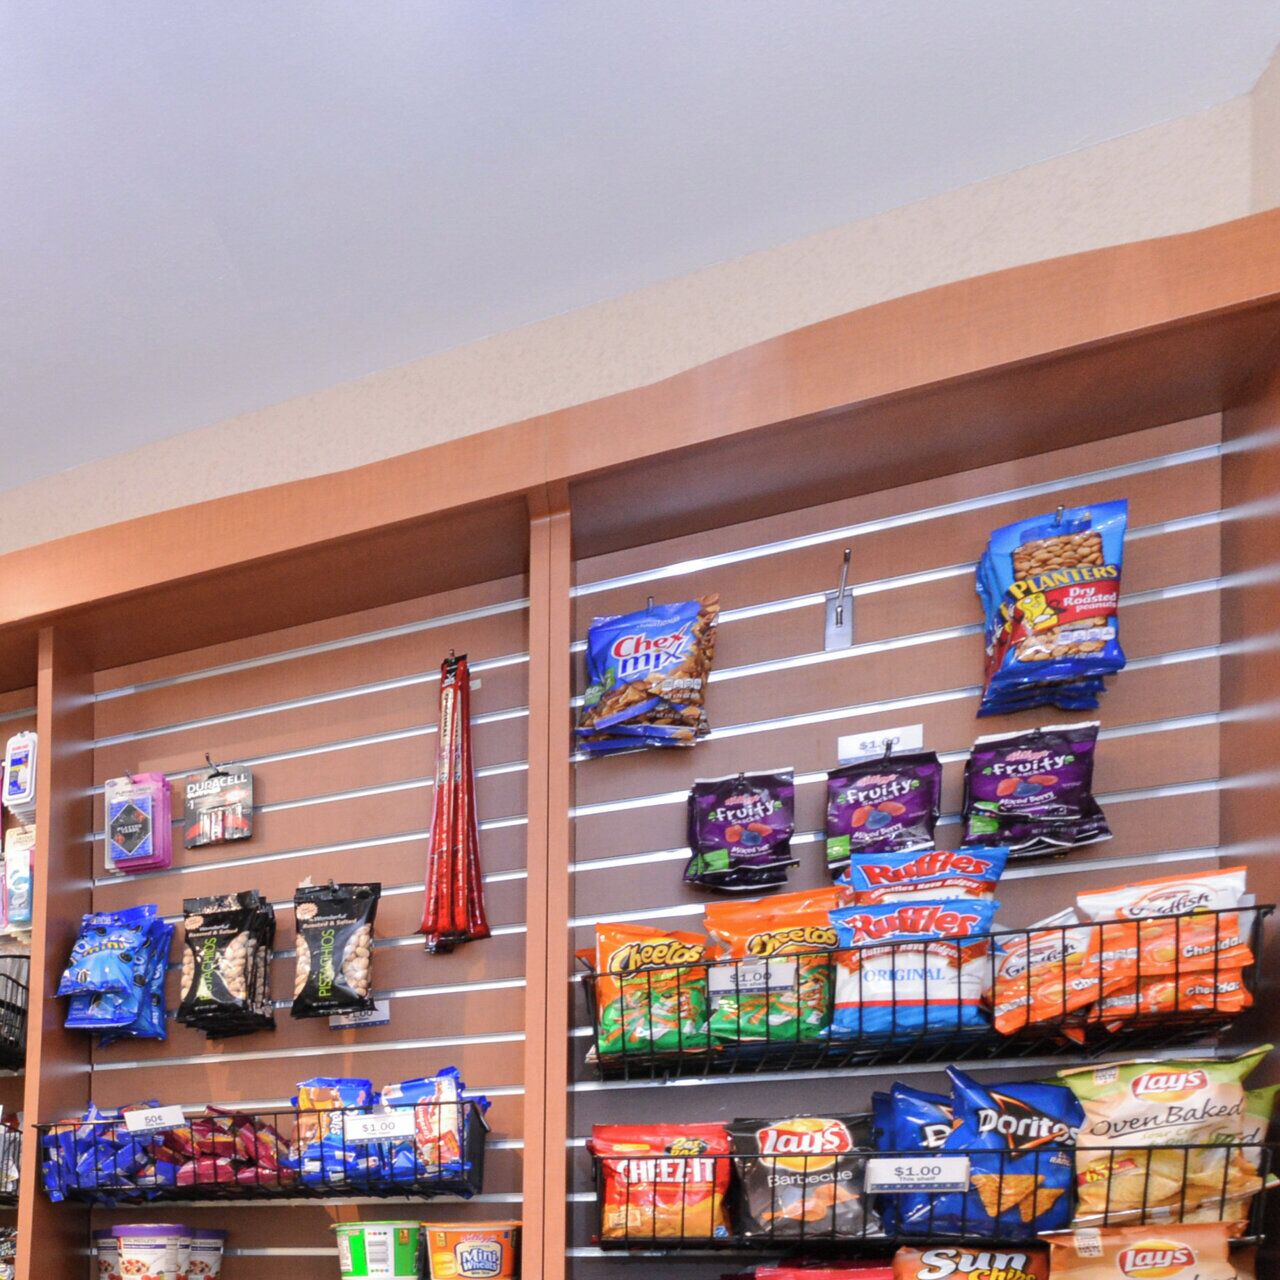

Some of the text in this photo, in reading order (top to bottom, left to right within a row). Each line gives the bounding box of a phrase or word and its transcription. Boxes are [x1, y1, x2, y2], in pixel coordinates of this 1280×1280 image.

[1009, 565, 1118, 600] PLANTERS
[1069, 587, 1096, 598] Dry
[1063, 592, 1118, 607] Roasted
[613, 622, 693, 658] Chex
[618, 637, 689, 678] mix
[993, 754, 1066, 778] Fruity
[187, 774, 247, 794] DURACELL
[846, 779, 912, 803] Fruity
[716, 800, 776, 823] Fruity
[864, 850, 992, 885] Ruffles
[844, 905, 982, 948] Ruffles
[746, 925, 839, 960] Cheetos
[318, 928, 335, 998] PISTACHIOS
[609, 942, 704, 982] Cheetos
[729, 971, 773, 986] $1.00
[863, 967, 946, 984] ORIGINAL
[144, 1114, 164, 1125] 50¢
[362, 1121, 396, 1133] $1.00
[979, 1108, 1079, 1146] Doritos
[1090, 1099, 1243, 1138] Oven Baked
[615, 1157, 716, 1184] CHEEZ-IT
[767, 1168, 853, 1188] Barbecue
[894, 1166, 941, 1178] $1.00
[463, 1259, 498, 1272] Wheats
